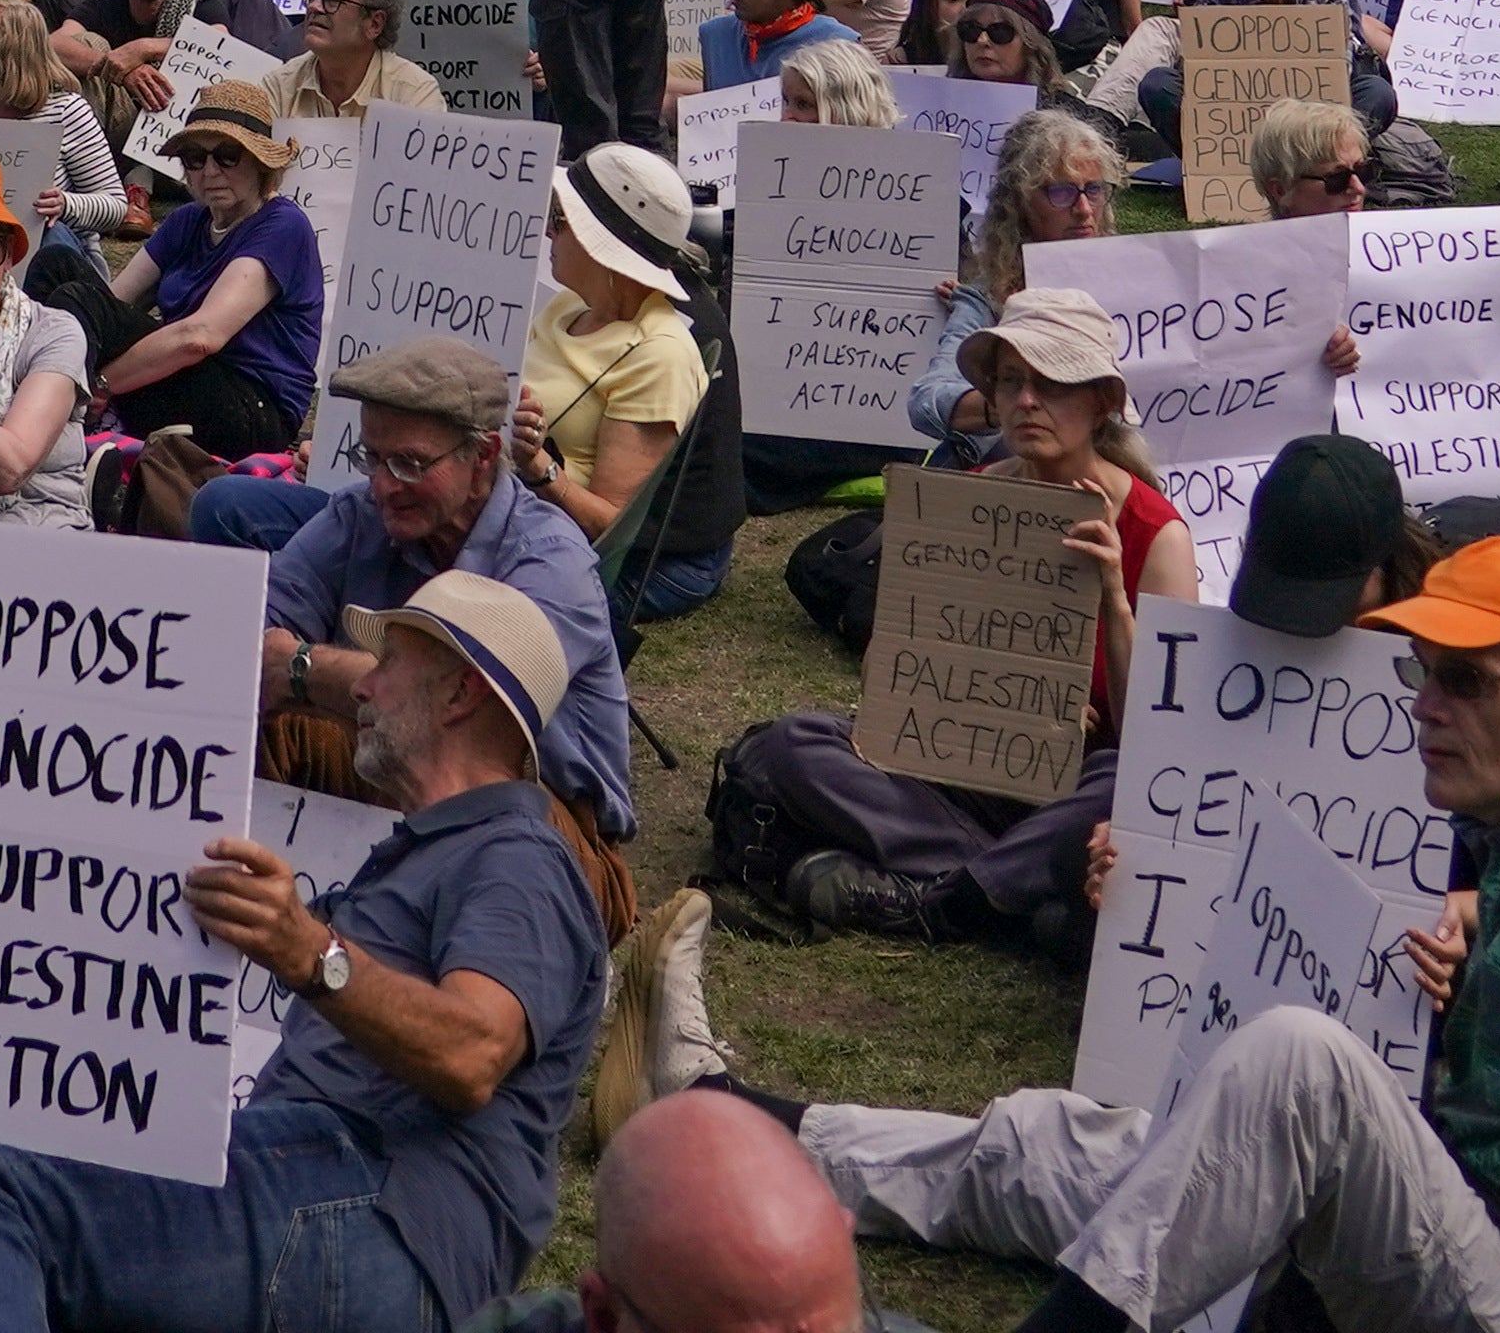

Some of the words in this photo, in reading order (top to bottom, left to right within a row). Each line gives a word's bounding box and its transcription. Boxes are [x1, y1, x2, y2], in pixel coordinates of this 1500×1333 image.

[409, 1, 516, 27] GENOCIDE
[1211, 18, 1333, 55] OPPOSE
[1192, 65, 1334, 103] GENOCIDE
[403, 125, 536, 184] OPPOSE
[818, 165, 933, 202] OPPOSE
[373, 182, 542, 260] GENOCIDE
[786, 215, 936, 262] GENOCIDE
[365, 267, 523, 348] SUPPORT
[812, 302, 934, 337] SUPPORT
[1348, 300, 1494, 335] GENOCIDE
[786, 343, 918, 376] PALESTINE
[790, 382, 897, 411] ACTION
[971, 503, 1075, 537] oppose
[903, 538, 1079, 587] GENOCIDE
[938, 600, 1096, 658] SUPPORT
[891, 650, 1083, 722] PALESTINE
[895, 708, 1073, 790] ACTION
